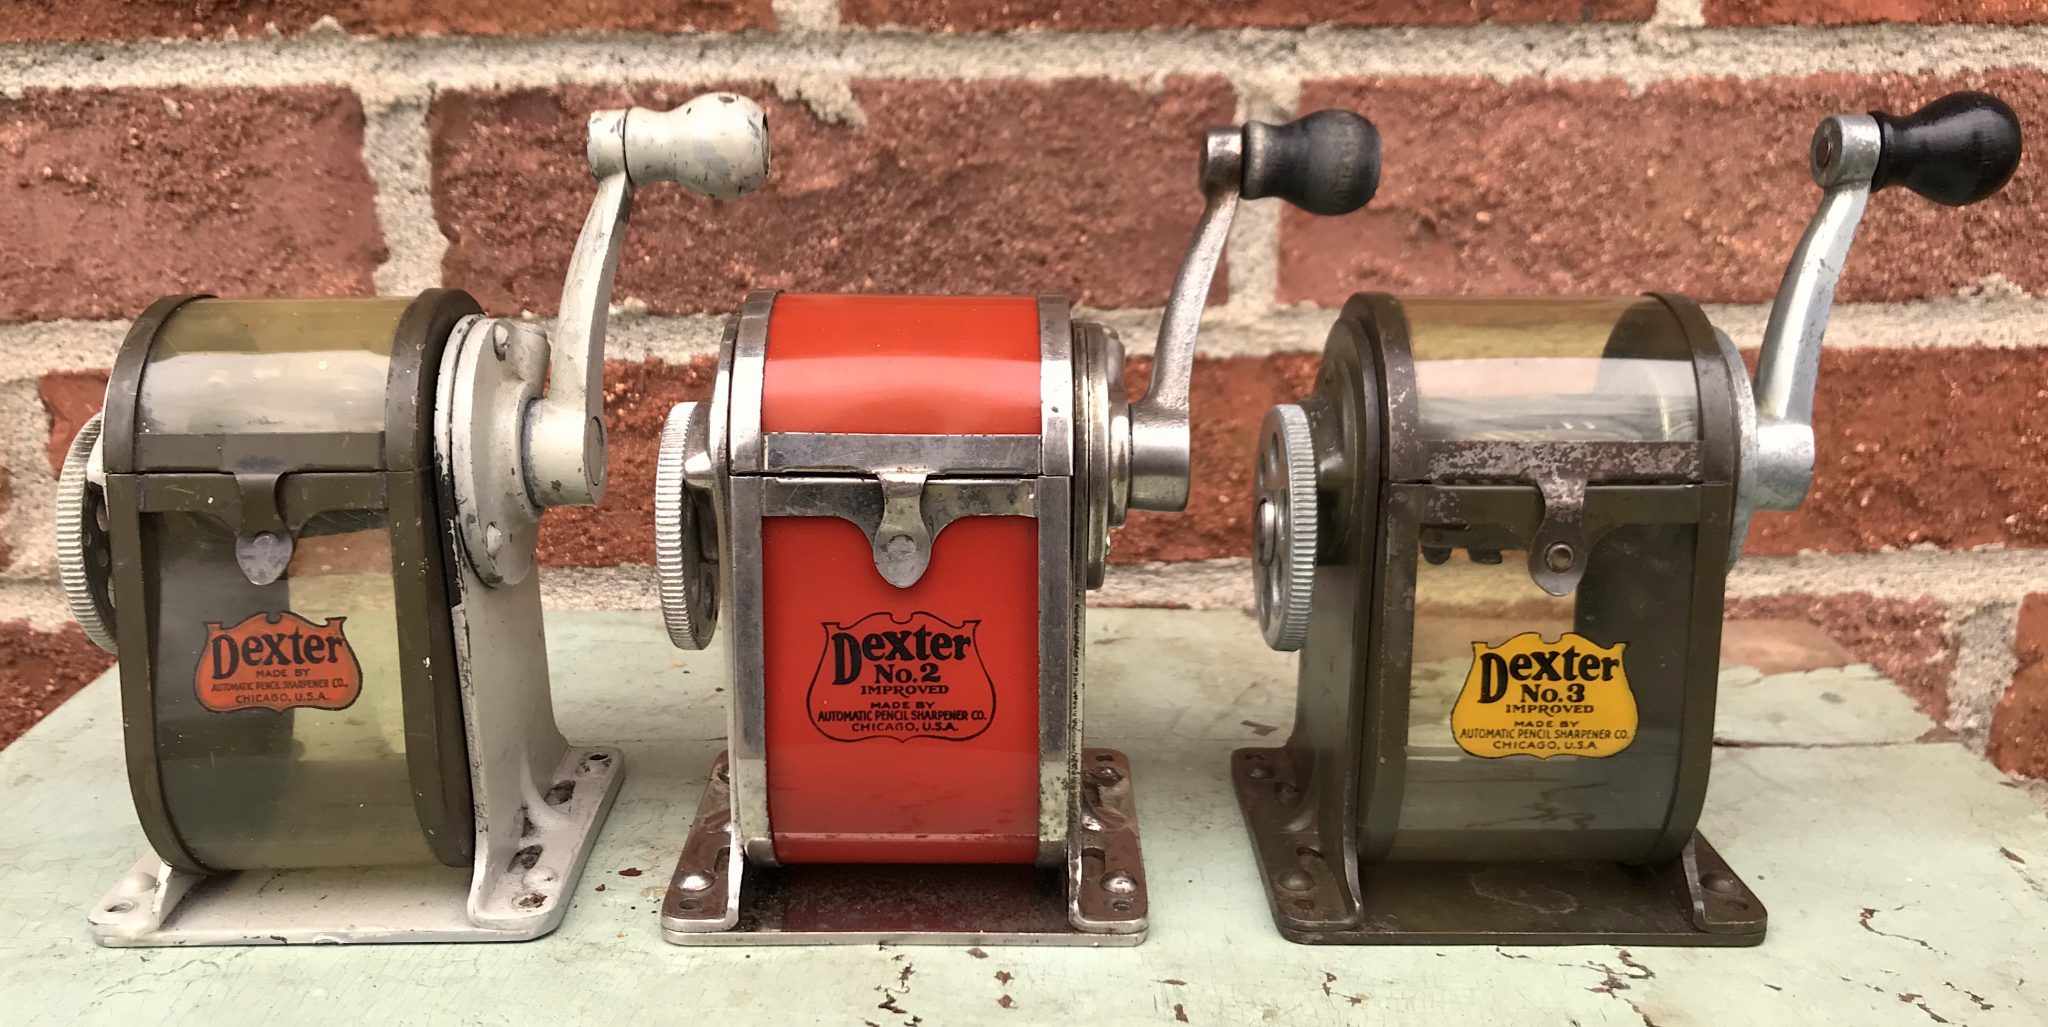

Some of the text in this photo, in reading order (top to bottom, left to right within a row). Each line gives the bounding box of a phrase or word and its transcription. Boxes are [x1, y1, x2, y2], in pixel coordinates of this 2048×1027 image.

[211, 627, 343, 679] Dexter
[831, 624, 971, 685] Dexter
[256, 668, 310, 678] MADE BY
[1477, 645, 1620, 704] Dexter
[211, 682, 255, 692] AUTOMATIC
[256, 681, 281, 691] PENCIL
[283, 679, 329, 690] SHARPENER
[860, 685, 949, 698] IMPROVED
[235, 692, 329, 704] CHICAGO, U.S.A.
[817, 710, 987, 722] AUTOMATIC PENCIL SHARPENER CO.
[1505, 704, 1594, 717] IMPROVED
[851, 722, 959, 732] CHICAGO, U.S.A.
[1514, 720, 1580, 728] MADE BY
[1459, 728, 1515, 739] AUTOMATIC
[1518, 728, 1552, 739] PENCIL
[1554, 729, 1611, 739] SHARPENER
[1493, 740, 1561, 750] CHICAGO,
